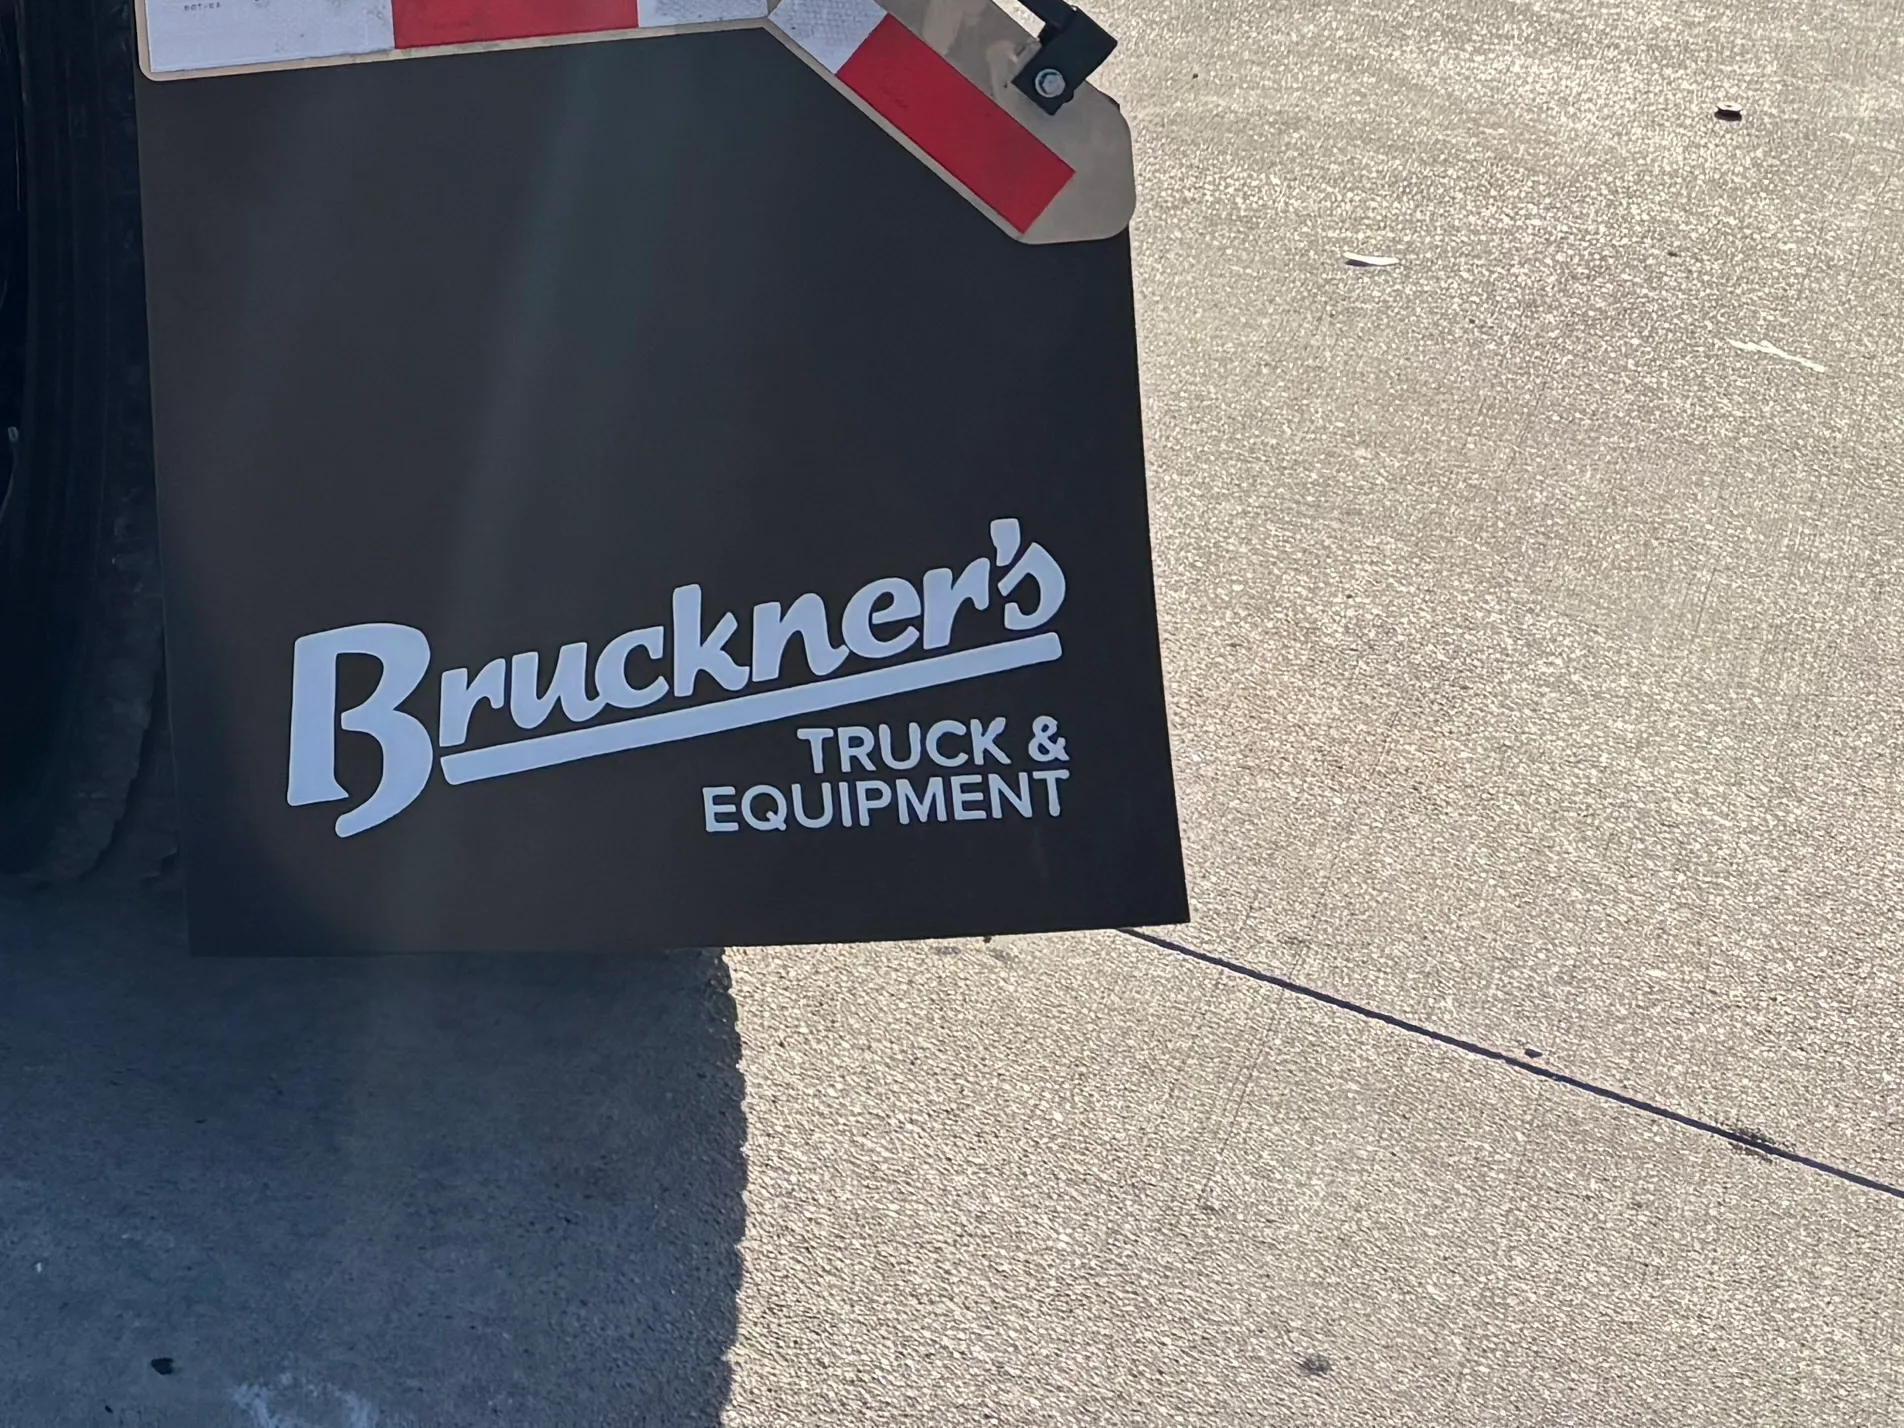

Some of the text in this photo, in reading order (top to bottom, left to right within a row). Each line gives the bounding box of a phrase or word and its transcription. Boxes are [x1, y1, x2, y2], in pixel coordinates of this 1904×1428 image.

[287, 519, 1066, 837] Bruckner's
[797, 716, 1069, 773] TRUCK &
[703, 770, 1069, 832] EQUIPMENT
